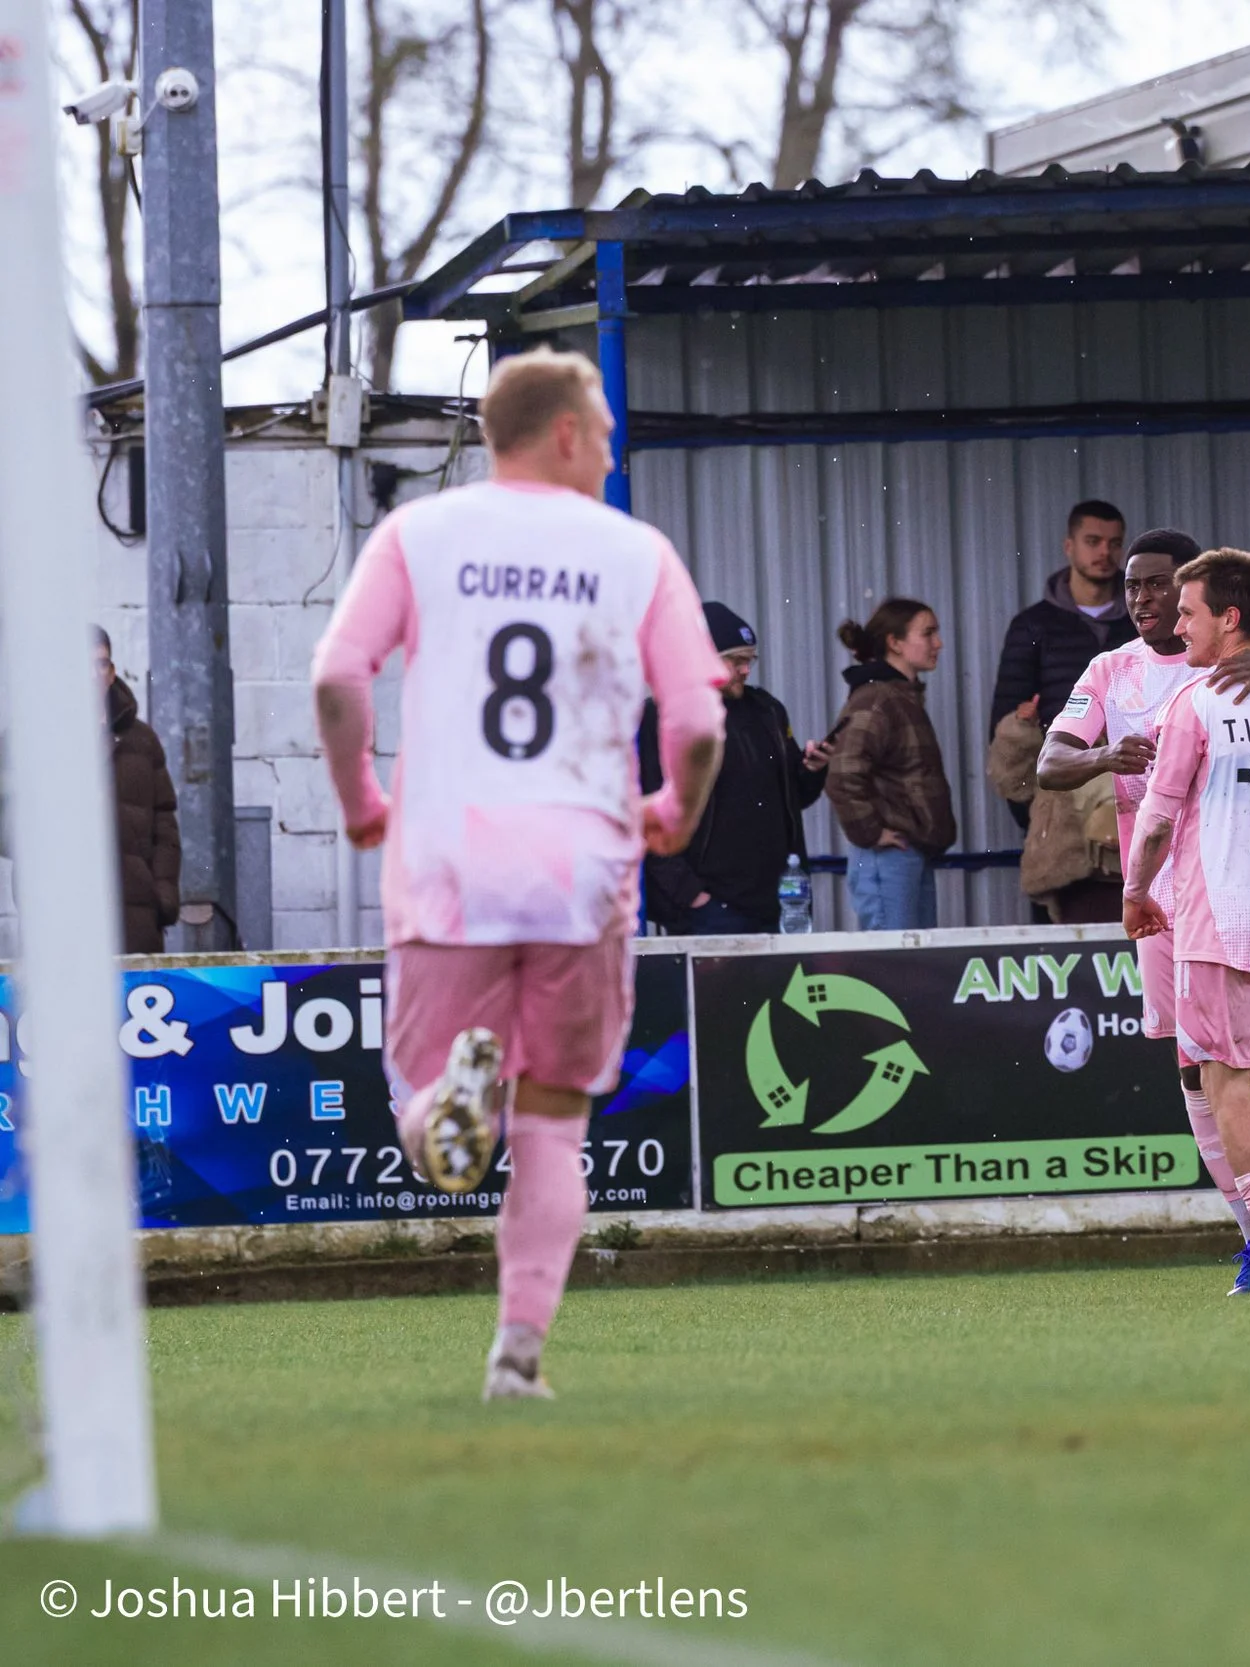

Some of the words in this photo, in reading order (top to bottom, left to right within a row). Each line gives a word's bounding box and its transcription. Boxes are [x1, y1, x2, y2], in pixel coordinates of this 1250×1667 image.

[458, 563, 599, 606] CURRAN
[482, 621, 555, 762] 8
[953, 953, 1082, 1004] ANY
[118, 984, 194, 1058] &
[230, 978, 384, 1055] Joi
[732, 1160, 912, 1195] Cheaper
[924, 1153, 1030, 1184] Than
[1044, 1157, 1068, 1179] a
[1082, 1145, 1176, 1182] Skip
[285, 1193, 351, 1212] Email:
